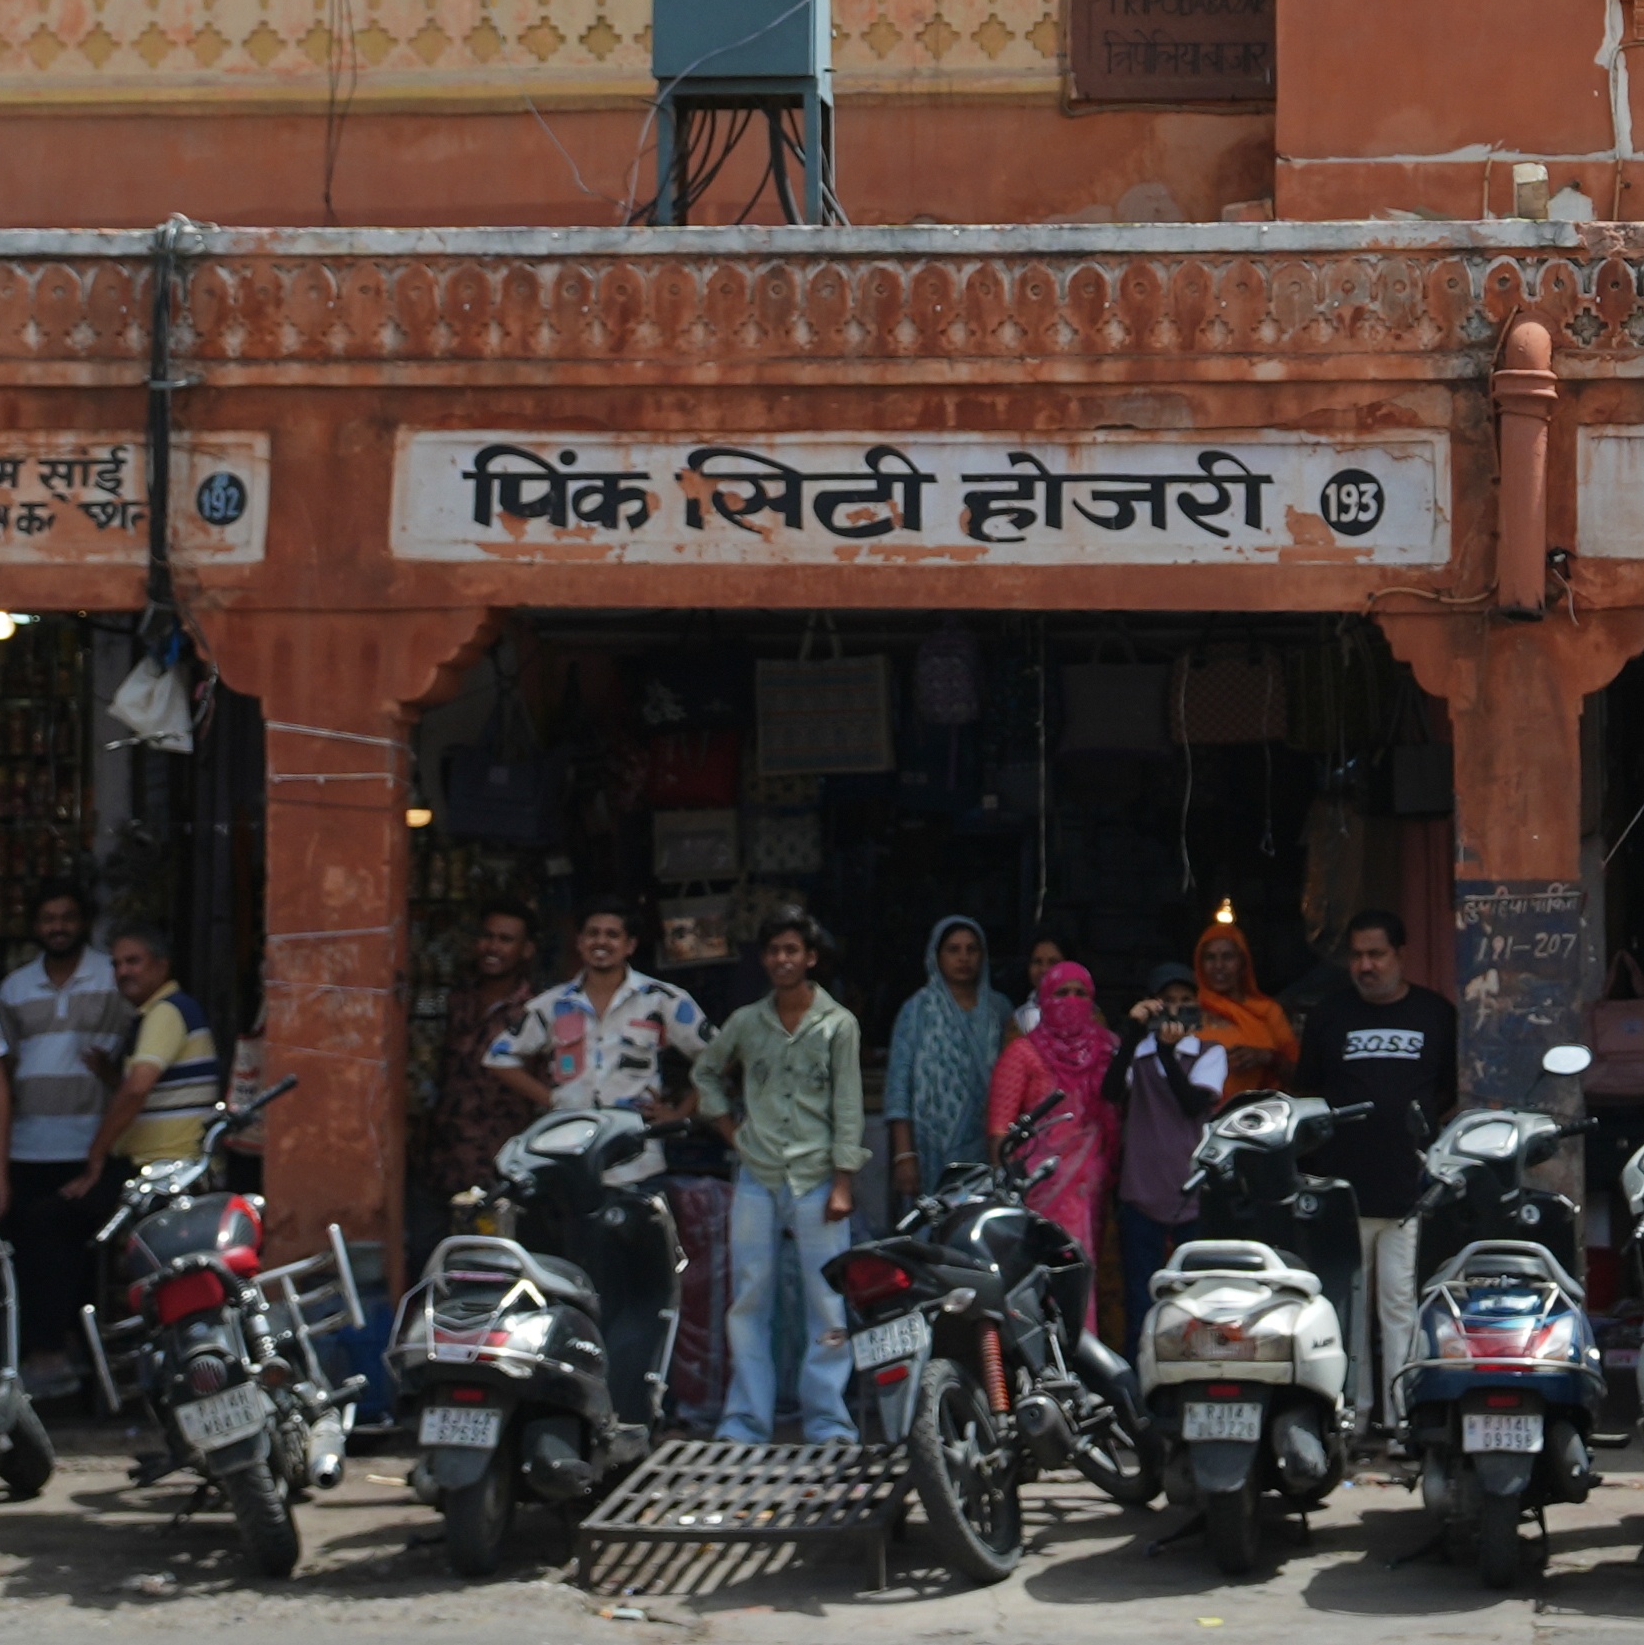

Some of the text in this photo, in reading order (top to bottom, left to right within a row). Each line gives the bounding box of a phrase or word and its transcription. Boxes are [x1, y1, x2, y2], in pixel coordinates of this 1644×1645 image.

[200, 487, 241, 518] 192
[463, 443, 1274, 544] पिंक सिटी होजरी
[1323, 481, 1379, 524] 193
